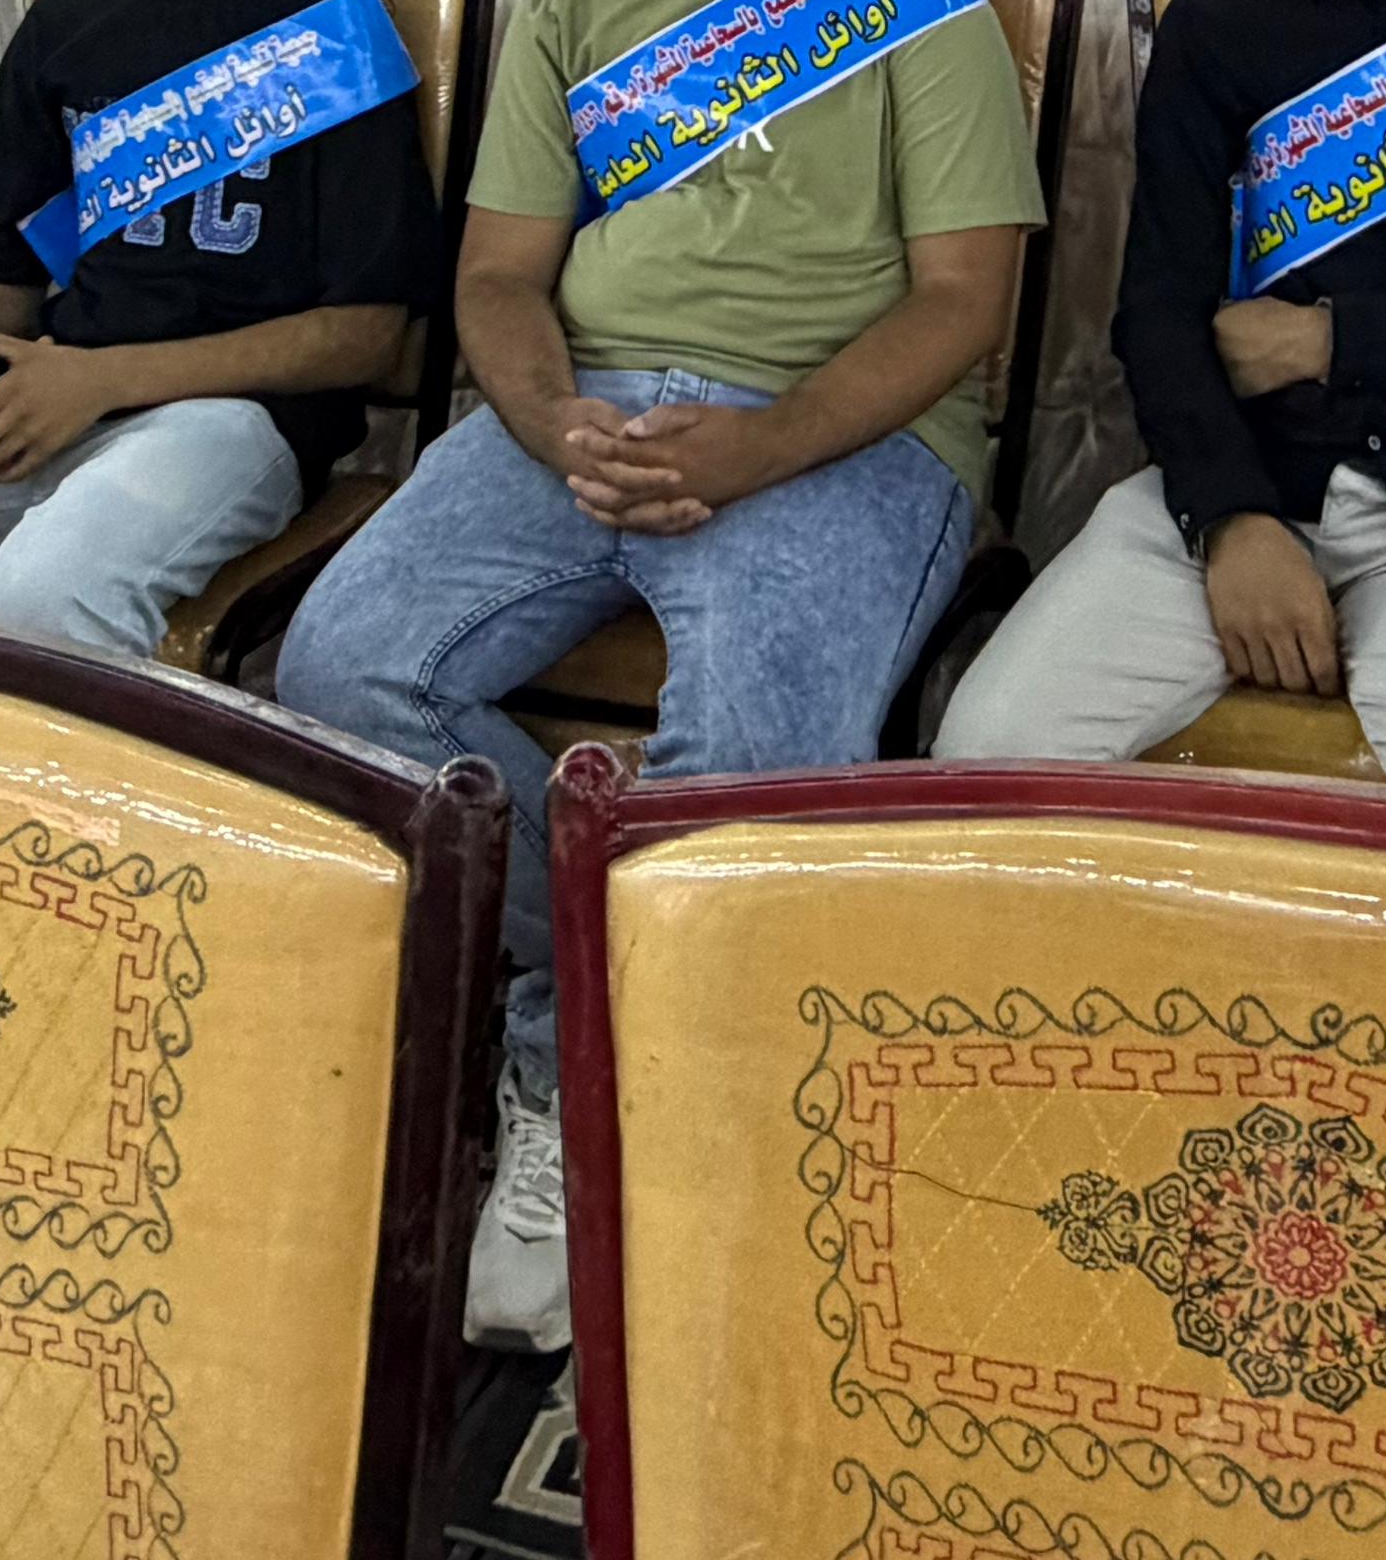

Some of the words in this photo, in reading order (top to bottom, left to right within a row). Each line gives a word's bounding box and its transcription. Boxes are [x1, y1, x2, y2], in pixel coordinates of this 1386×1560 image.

[225, 83, 307, 159] أوائل
[656, 42, 801, 149] الثانوية
[101, 133, 216, 213] الثانوية
